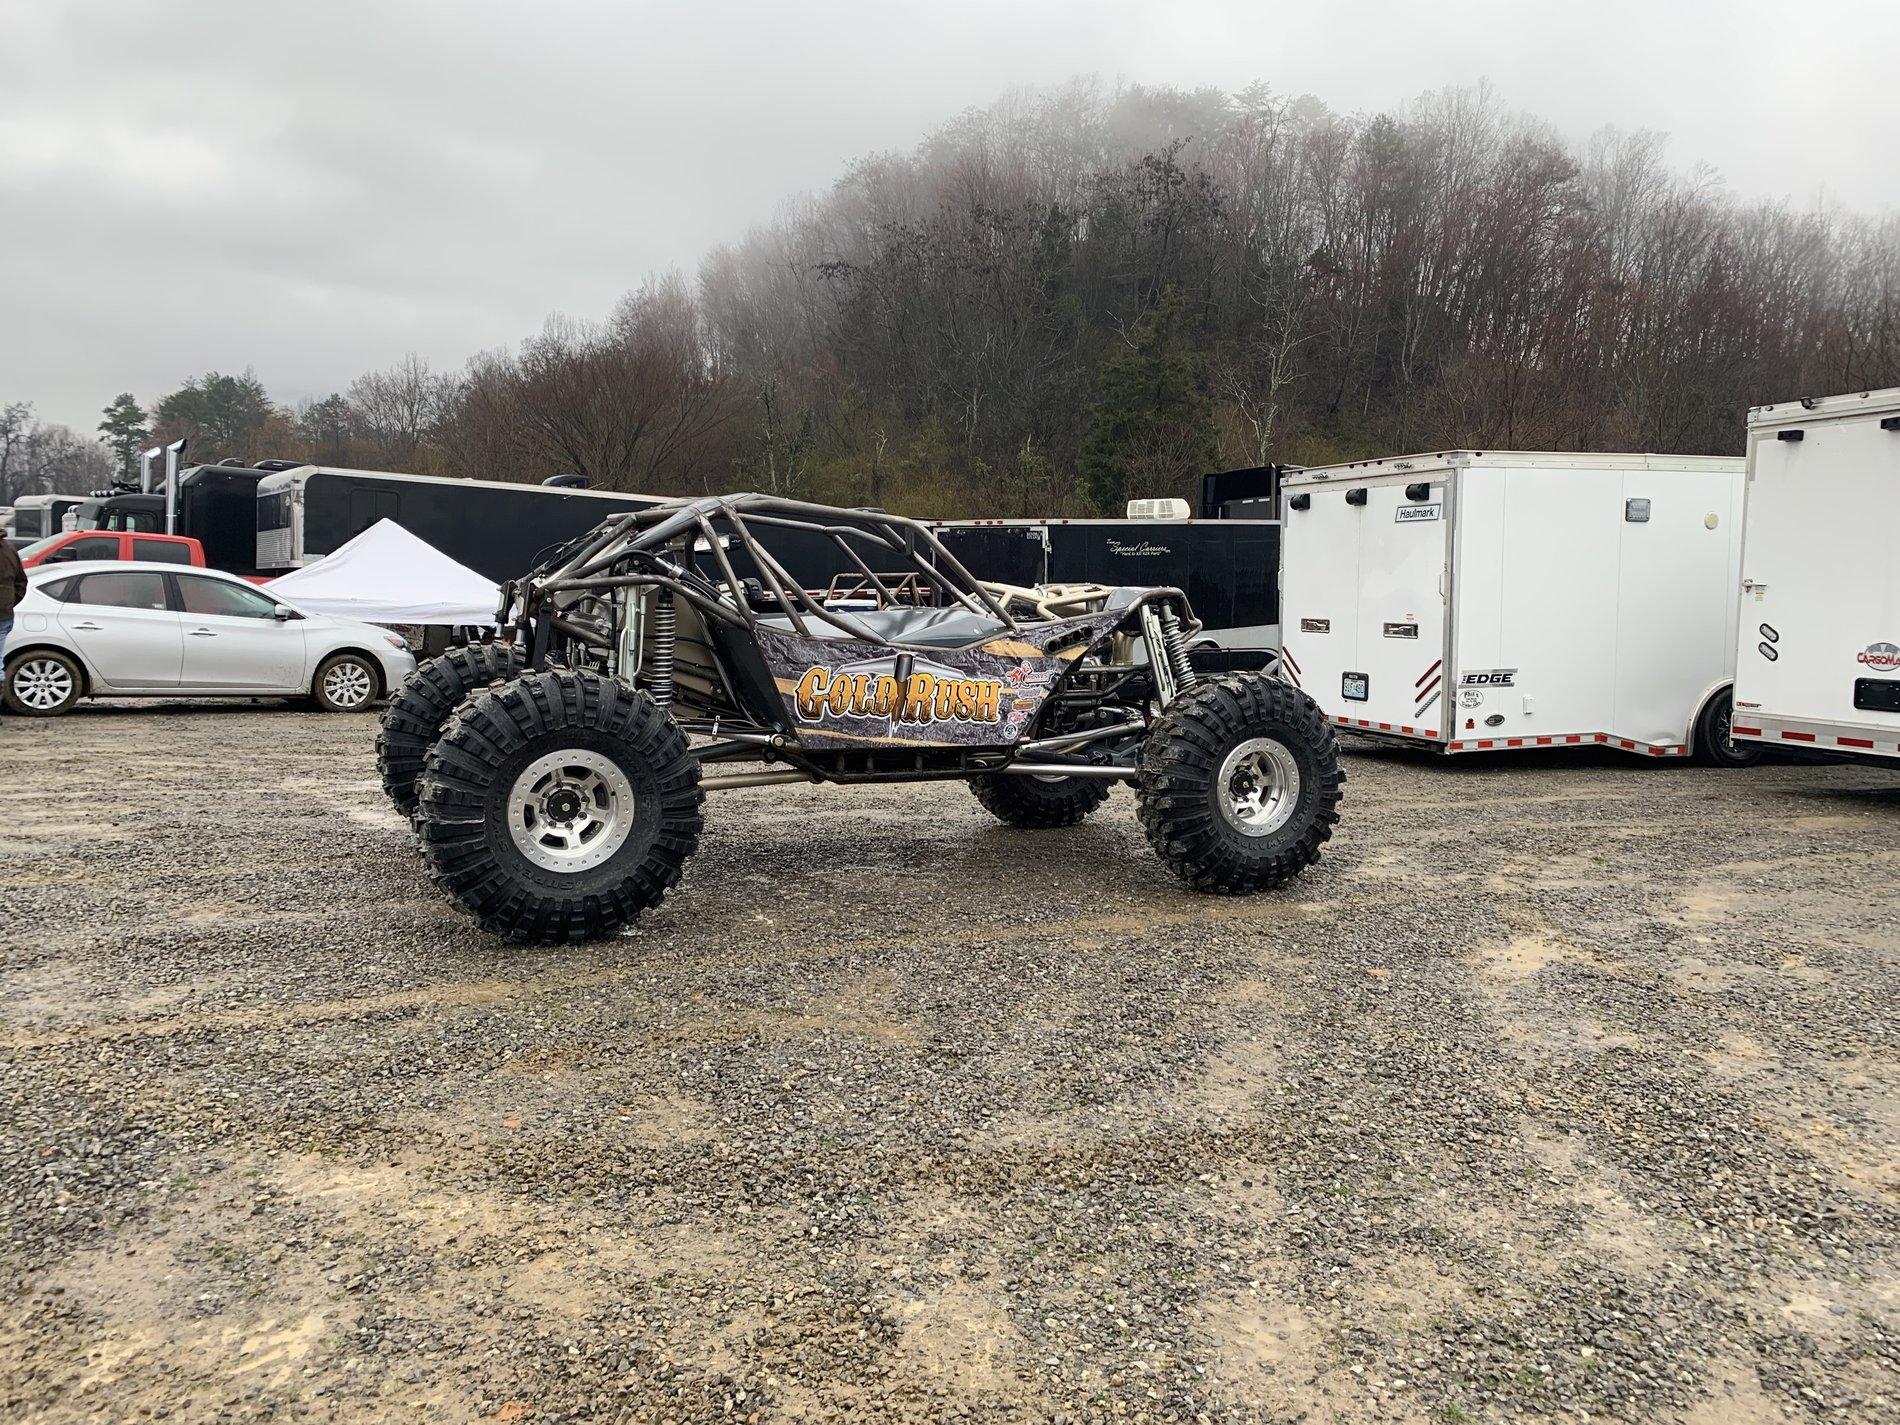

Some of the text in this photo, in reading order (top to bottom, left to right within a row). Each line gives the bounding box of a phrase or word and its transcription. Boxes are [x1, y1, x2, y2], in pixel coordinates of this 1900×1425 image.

[1399, 508, 1434, 519] Haulmark
[1109, 542, 1141, 555] Special
[1465, 673, 1513, 684] EDGE
[794, 666, 899, 720] GOLD
[899, 672, 1003, 724] RUSH
[1290, 783, 1314, 832] SUPER
[512, 862, 574, 890] SUPER
